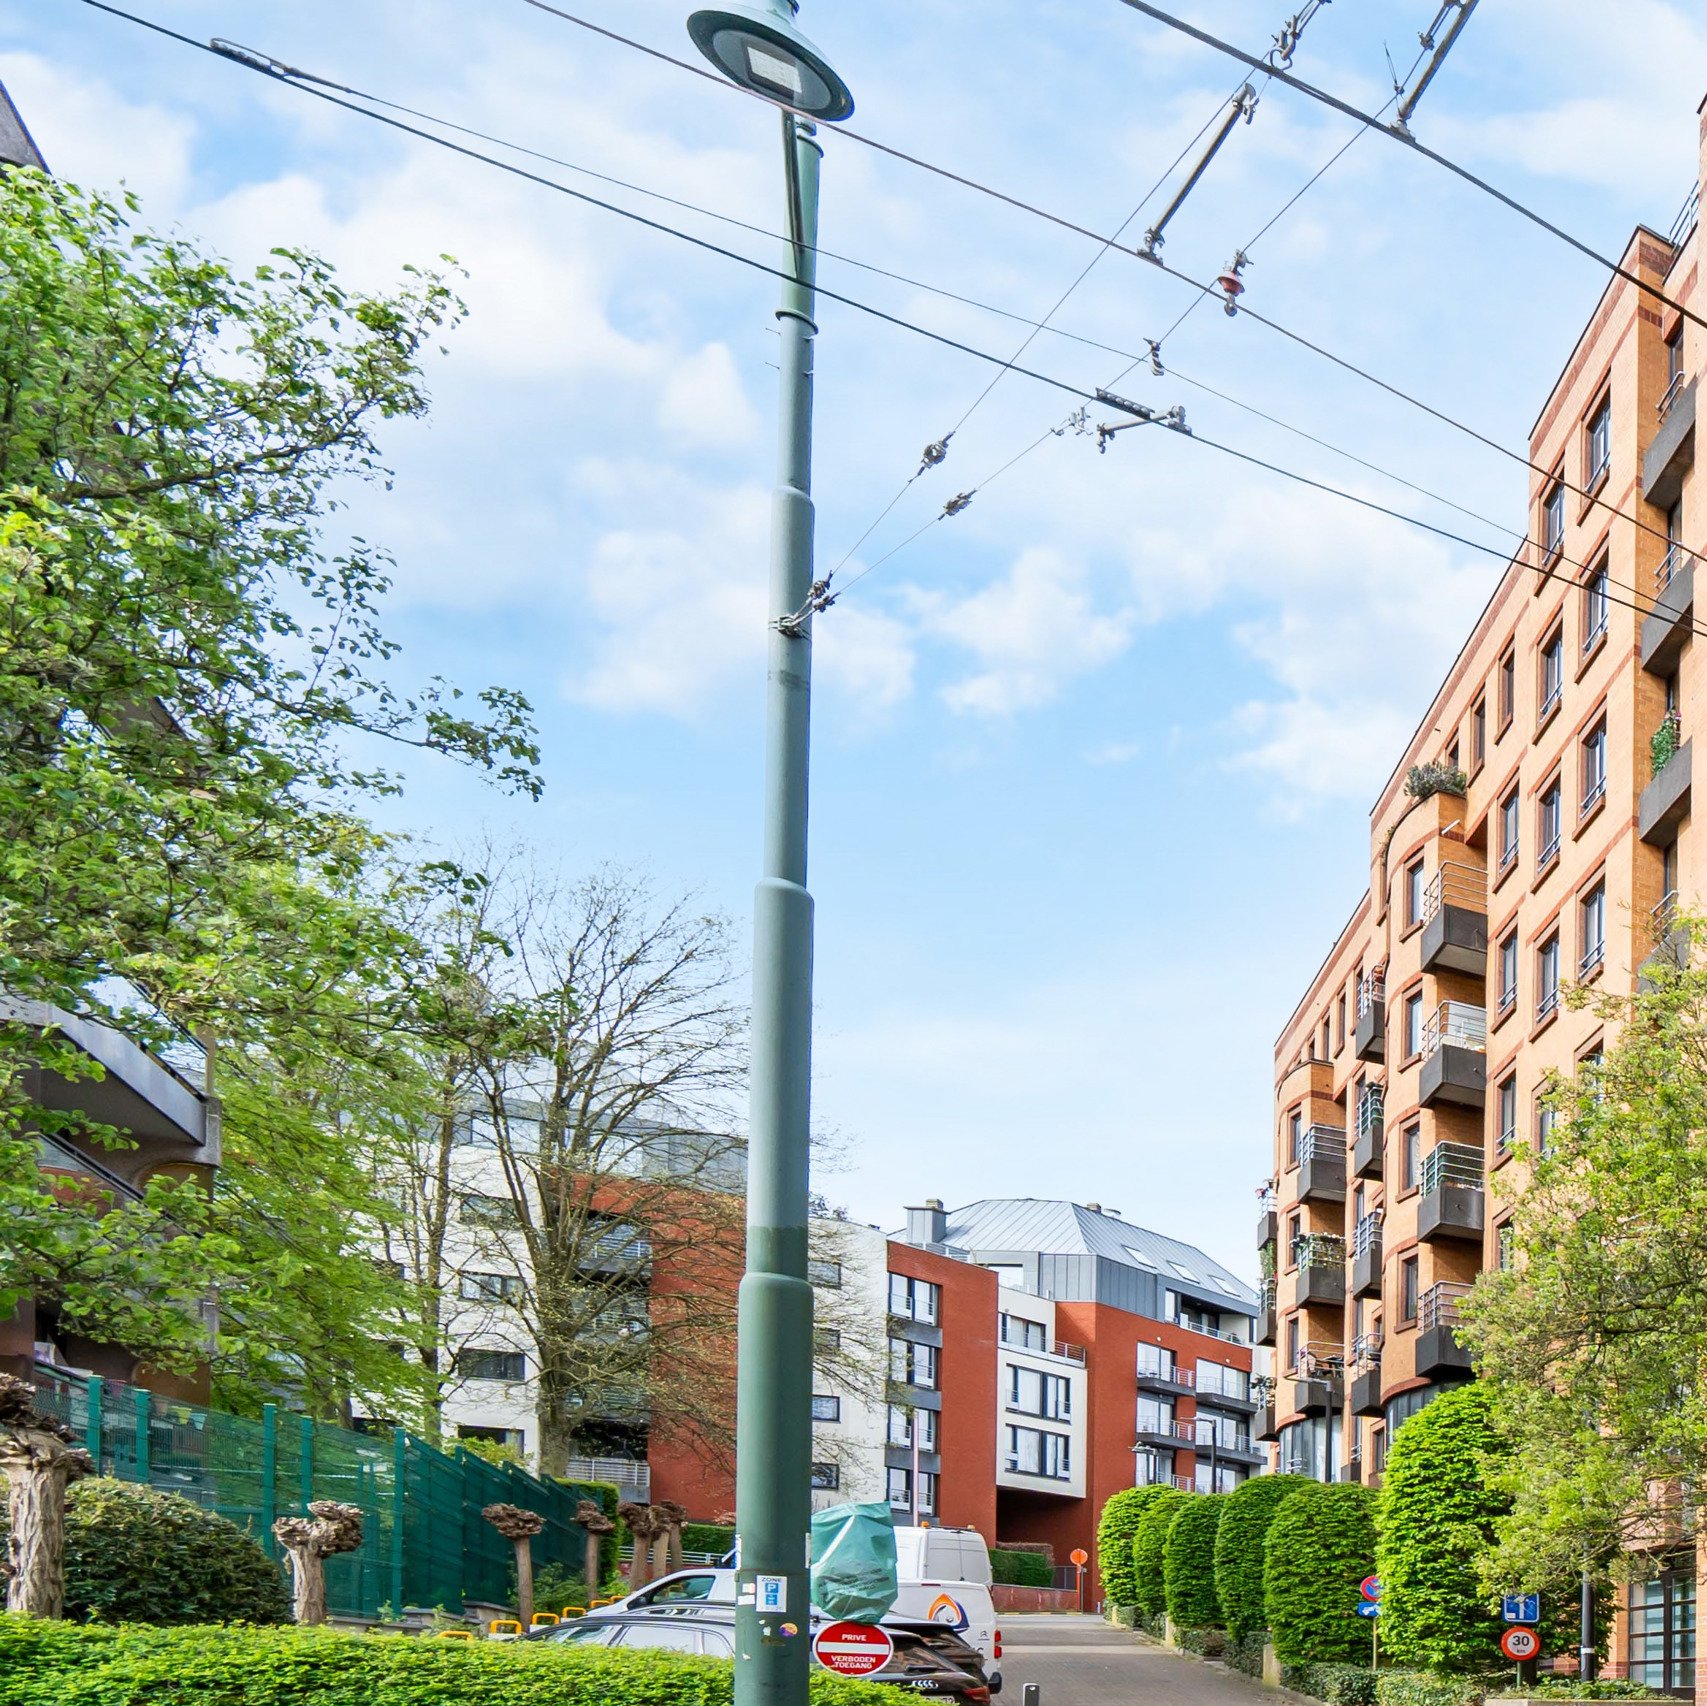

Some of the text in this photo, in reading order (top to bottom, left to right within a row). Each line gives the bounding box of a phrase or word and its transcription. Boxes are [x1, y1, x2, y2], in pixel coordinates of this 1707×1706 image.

[841, 1633, 867, 1641] PRIVE
[1512, 1635, 1530, 1647] 30
[831, 1655, 876, 1663] VERBODEN
